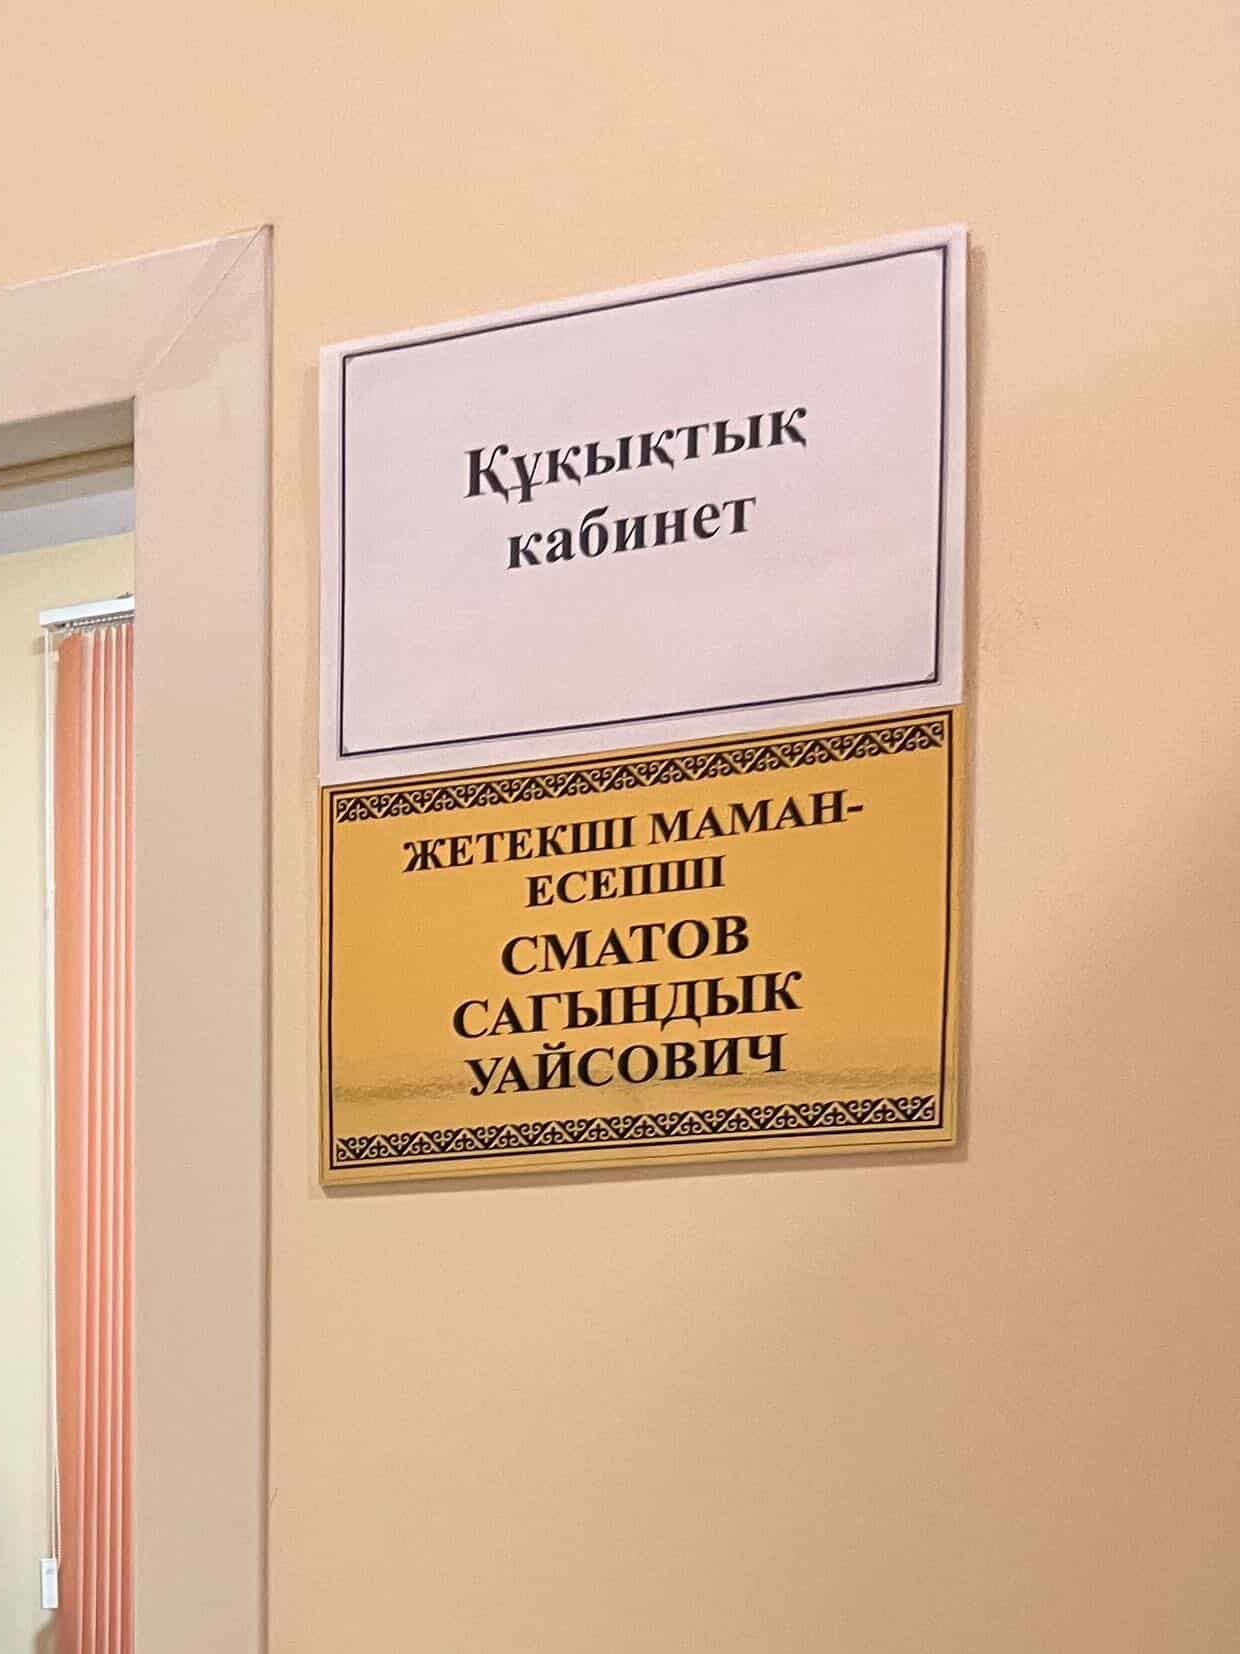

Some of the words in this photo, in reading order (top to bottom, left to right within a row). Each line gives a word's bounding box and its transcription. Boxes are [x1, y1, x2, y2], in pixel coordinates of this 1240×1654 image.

[464, 404, 808, 504] Құқықтық
[506, 490, 758, 569] кабинет
[402, 815, 637, 873] ЖЕТЕКШІ
[648, 788, 865, 846] МАМАН-
[524, 855, 726, 908] ЕСЕПШІ
[501, 915, 750, 976] СМАТОВ
[453, 970, 804, 1039] САГЫНДЫК
[464, 1033, 789, 1096] УАЙСОВИЧ
